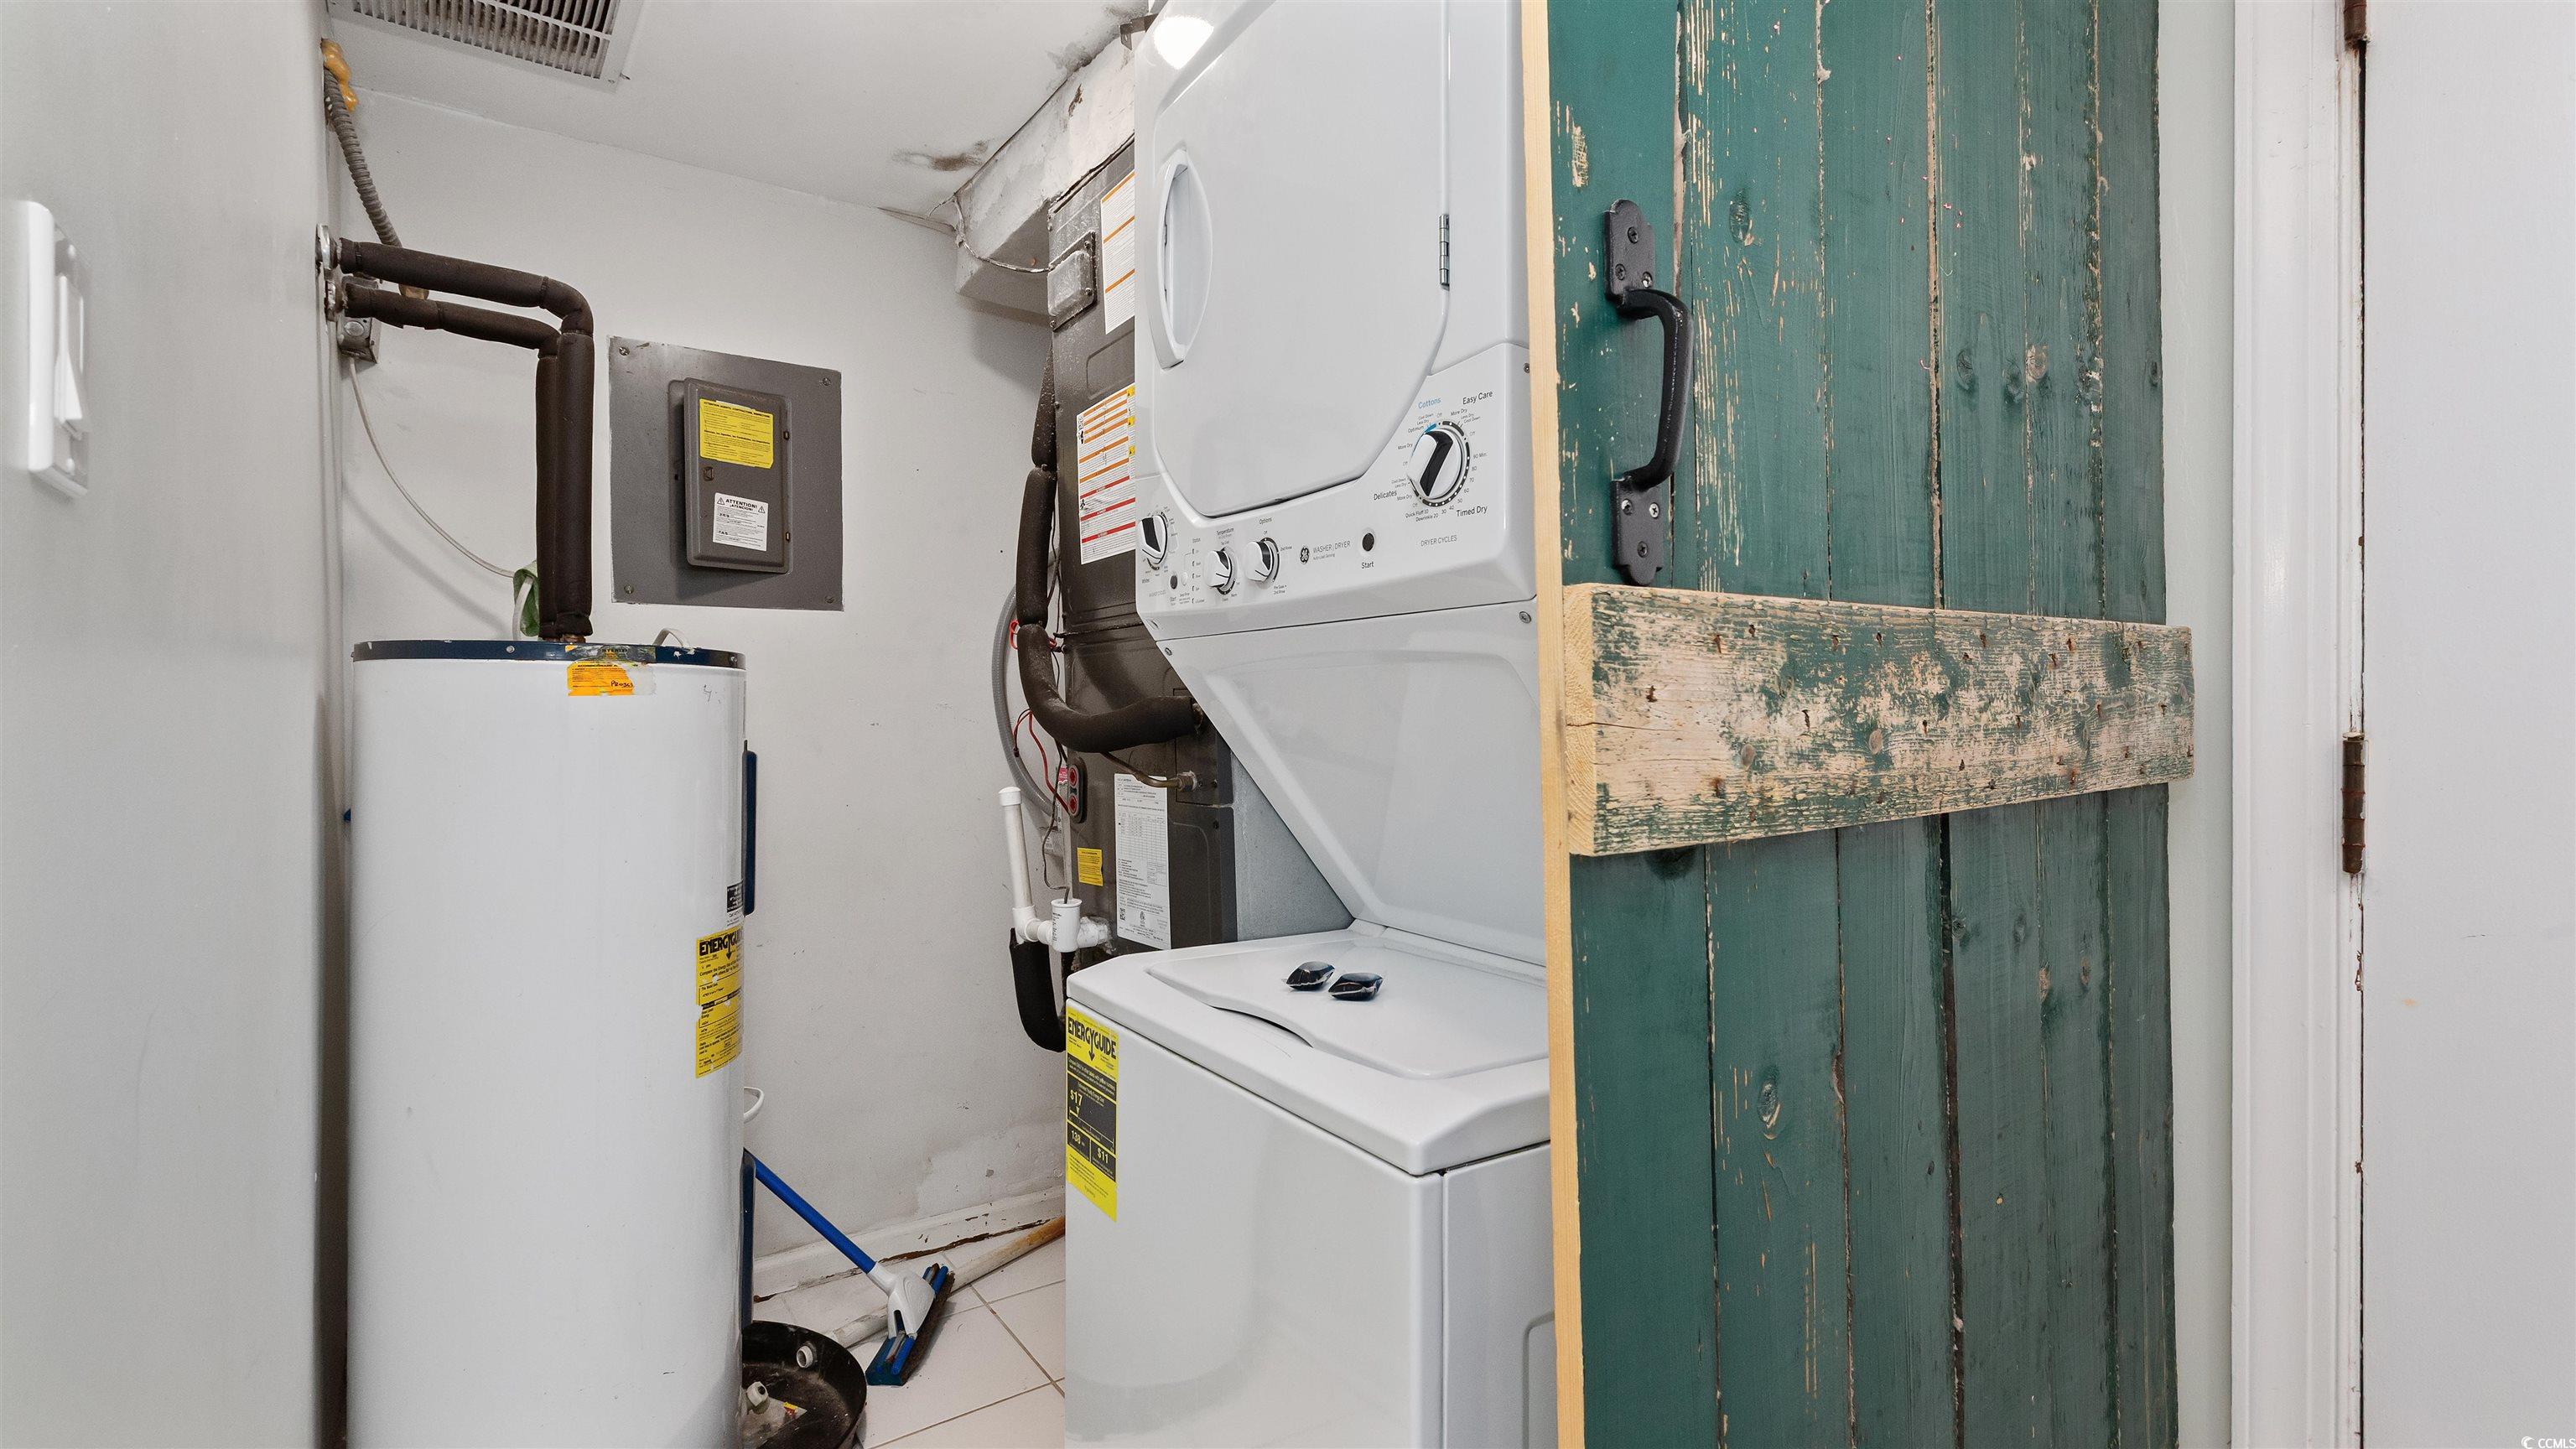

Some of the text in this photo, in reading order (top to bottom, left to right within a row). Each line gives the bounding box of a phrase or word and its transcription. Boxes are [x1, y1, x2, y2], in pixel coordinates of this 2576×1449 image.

[1418, 397, 1441, 409] Cottons
[1462, 391, 1493, 405] Easy Care
[1407, 425, 1424, 434] Optimum
[1374, 489, 1398, 501] Delicates
[725, 498, 758, 509] ATTENTION!
[1405, 511, 1415, 519] Quick
[1457, 505, 1488, 517] Timed Dry
[1259, 517, 1272, 525] Options
[1420, 534, 1457, 547] DRYER CYCLES
[1312, 541, 1351, 554] WASHER DRYER
[1361, 561, 1374, 569] Start
[699, 929, 744, 958] ENERGYGUI
[1067, 1015, 1117, 1060] ENERGYGUIDE
[1070, 1089, 1083, 1107] $17
[1097, 1147, 1109, 1164] $11
